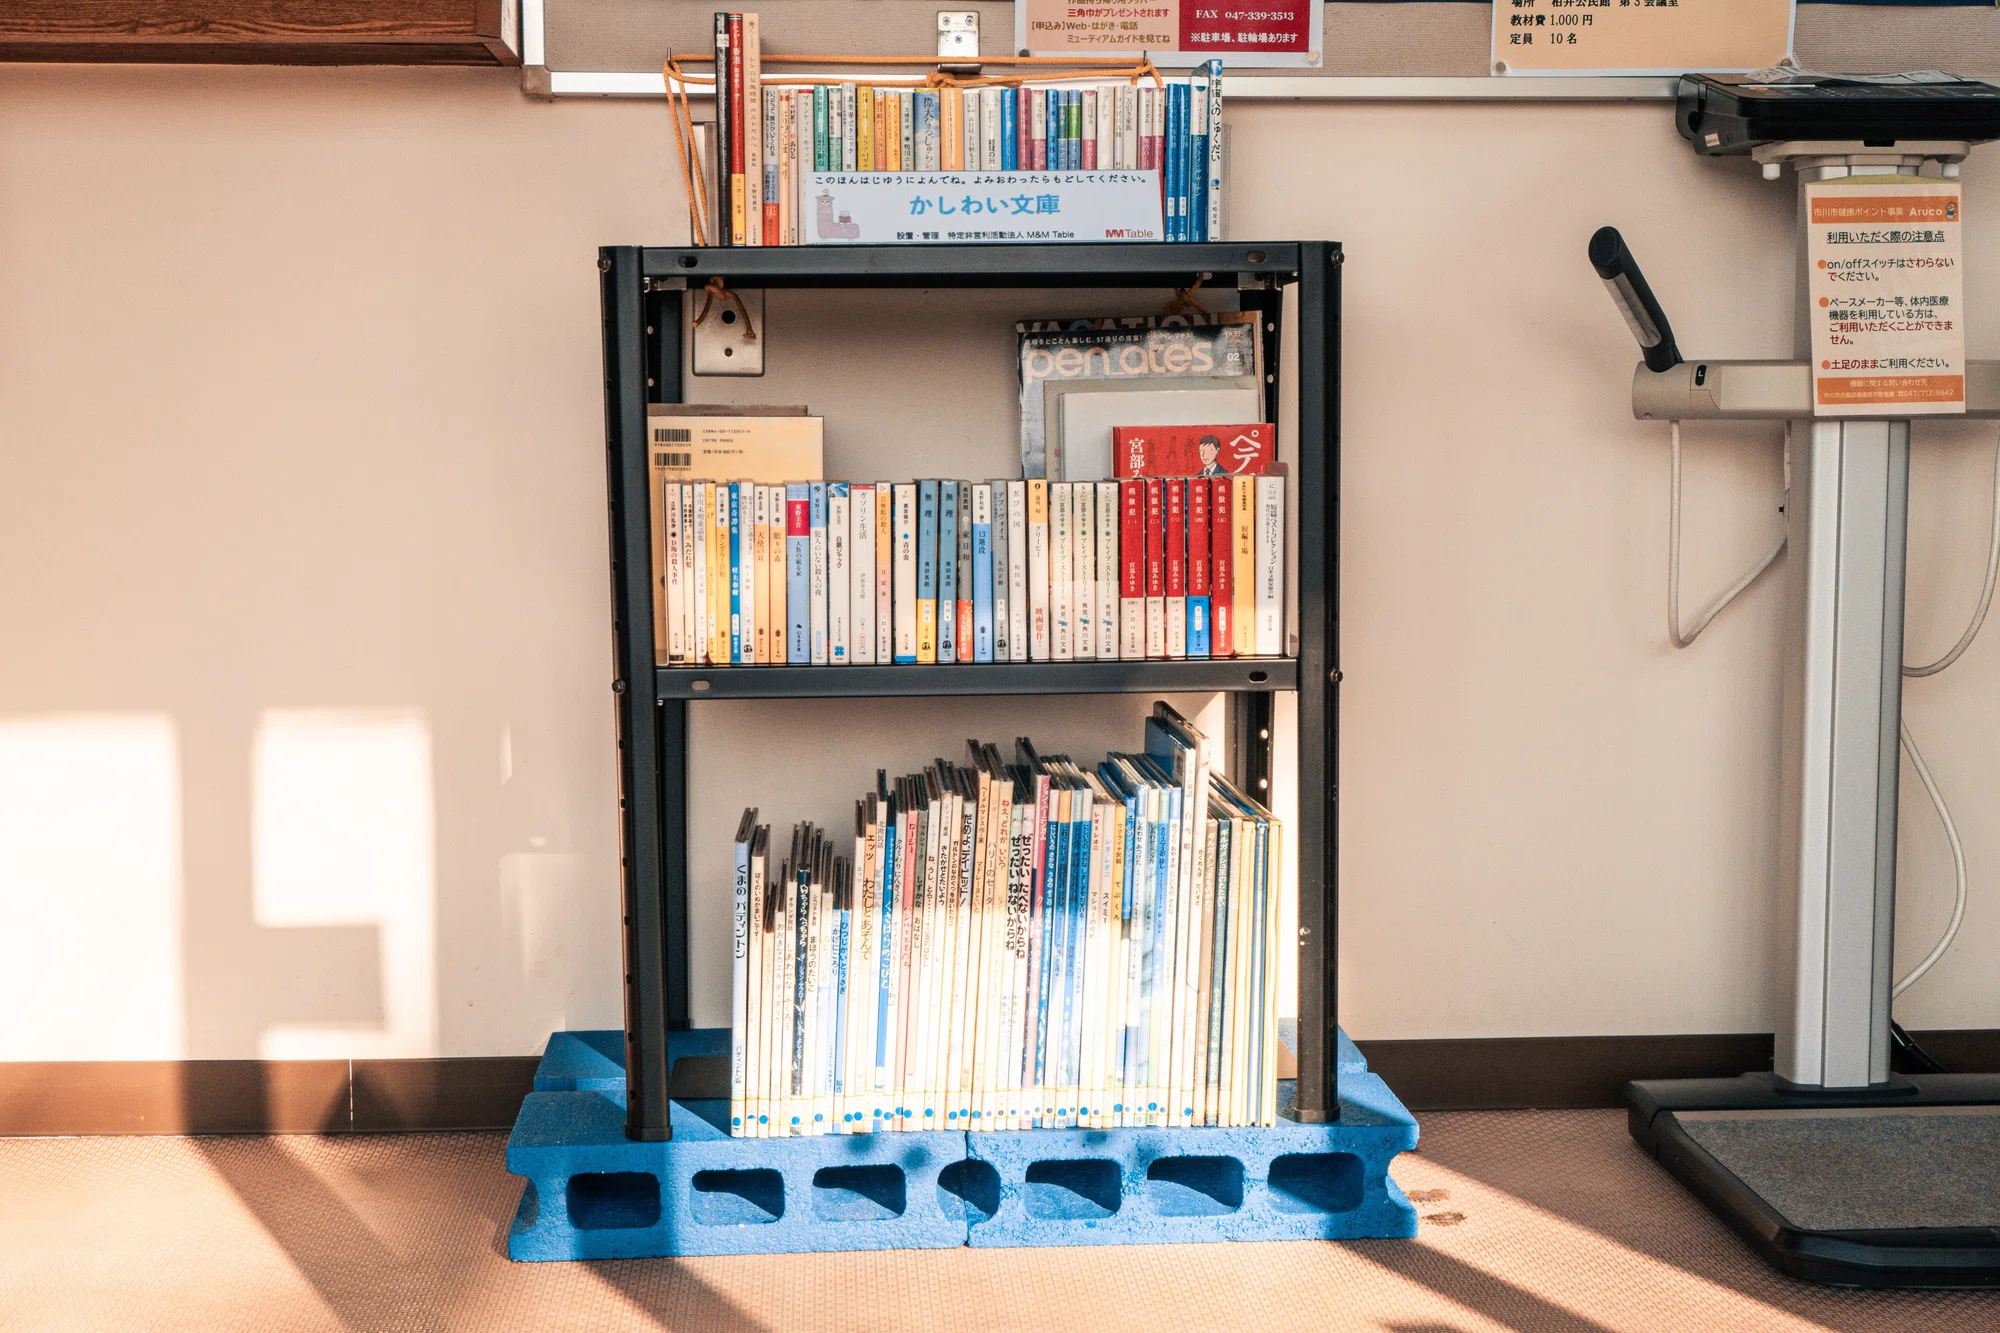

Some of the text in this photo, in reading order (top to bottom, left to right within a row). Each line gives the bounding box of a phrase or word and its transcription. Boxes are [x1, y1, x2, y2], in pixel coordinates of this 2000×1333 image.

[1067, 8, 1170, 17] 三角巾がプレゼントされます
[1196, 10, 1295, 20] FAX 047-339-3513
[1510, 14, 1593, 26] 教材費 1,000 円
[1510, 33, 1577, 45] 定員 10 名
[1211, 78, 1221, 162] 宇宙人のしゅくだい
[909, 194, 1061, 216] かしわい文庫
[1813, 207, 1944, 218] 市川市健康ポイント事業 Aruco
[897, 231, 940, 241] 設置・管理
[1027, 231, 1050, 239] M&M
[1053, 231, 1075, 239] Table
[1827, 230, 1945, 244] 利用いただく際の注意点
[1827, 258, 1955, 270] on/offスイッチはさわらない
[1828, 270, 1880, 281] でください。
[1829, 296, 1949, 307] ペースメーカー等、体内医療
[1829, 309, 1938, 321] 機器を利用している方は、
[1829, 320, 1954, 333] ご利用いただくことができま
[1830, 335, 1854, 345] せん。
[1831, 358, 1951, 370] 土足のままご利用ください。
[859, 491, 868, 540] ガソリン生活
[813, 530, 822, 596] 犯人のいない殺人の夜
[736, 864, 747, 897] くまの
